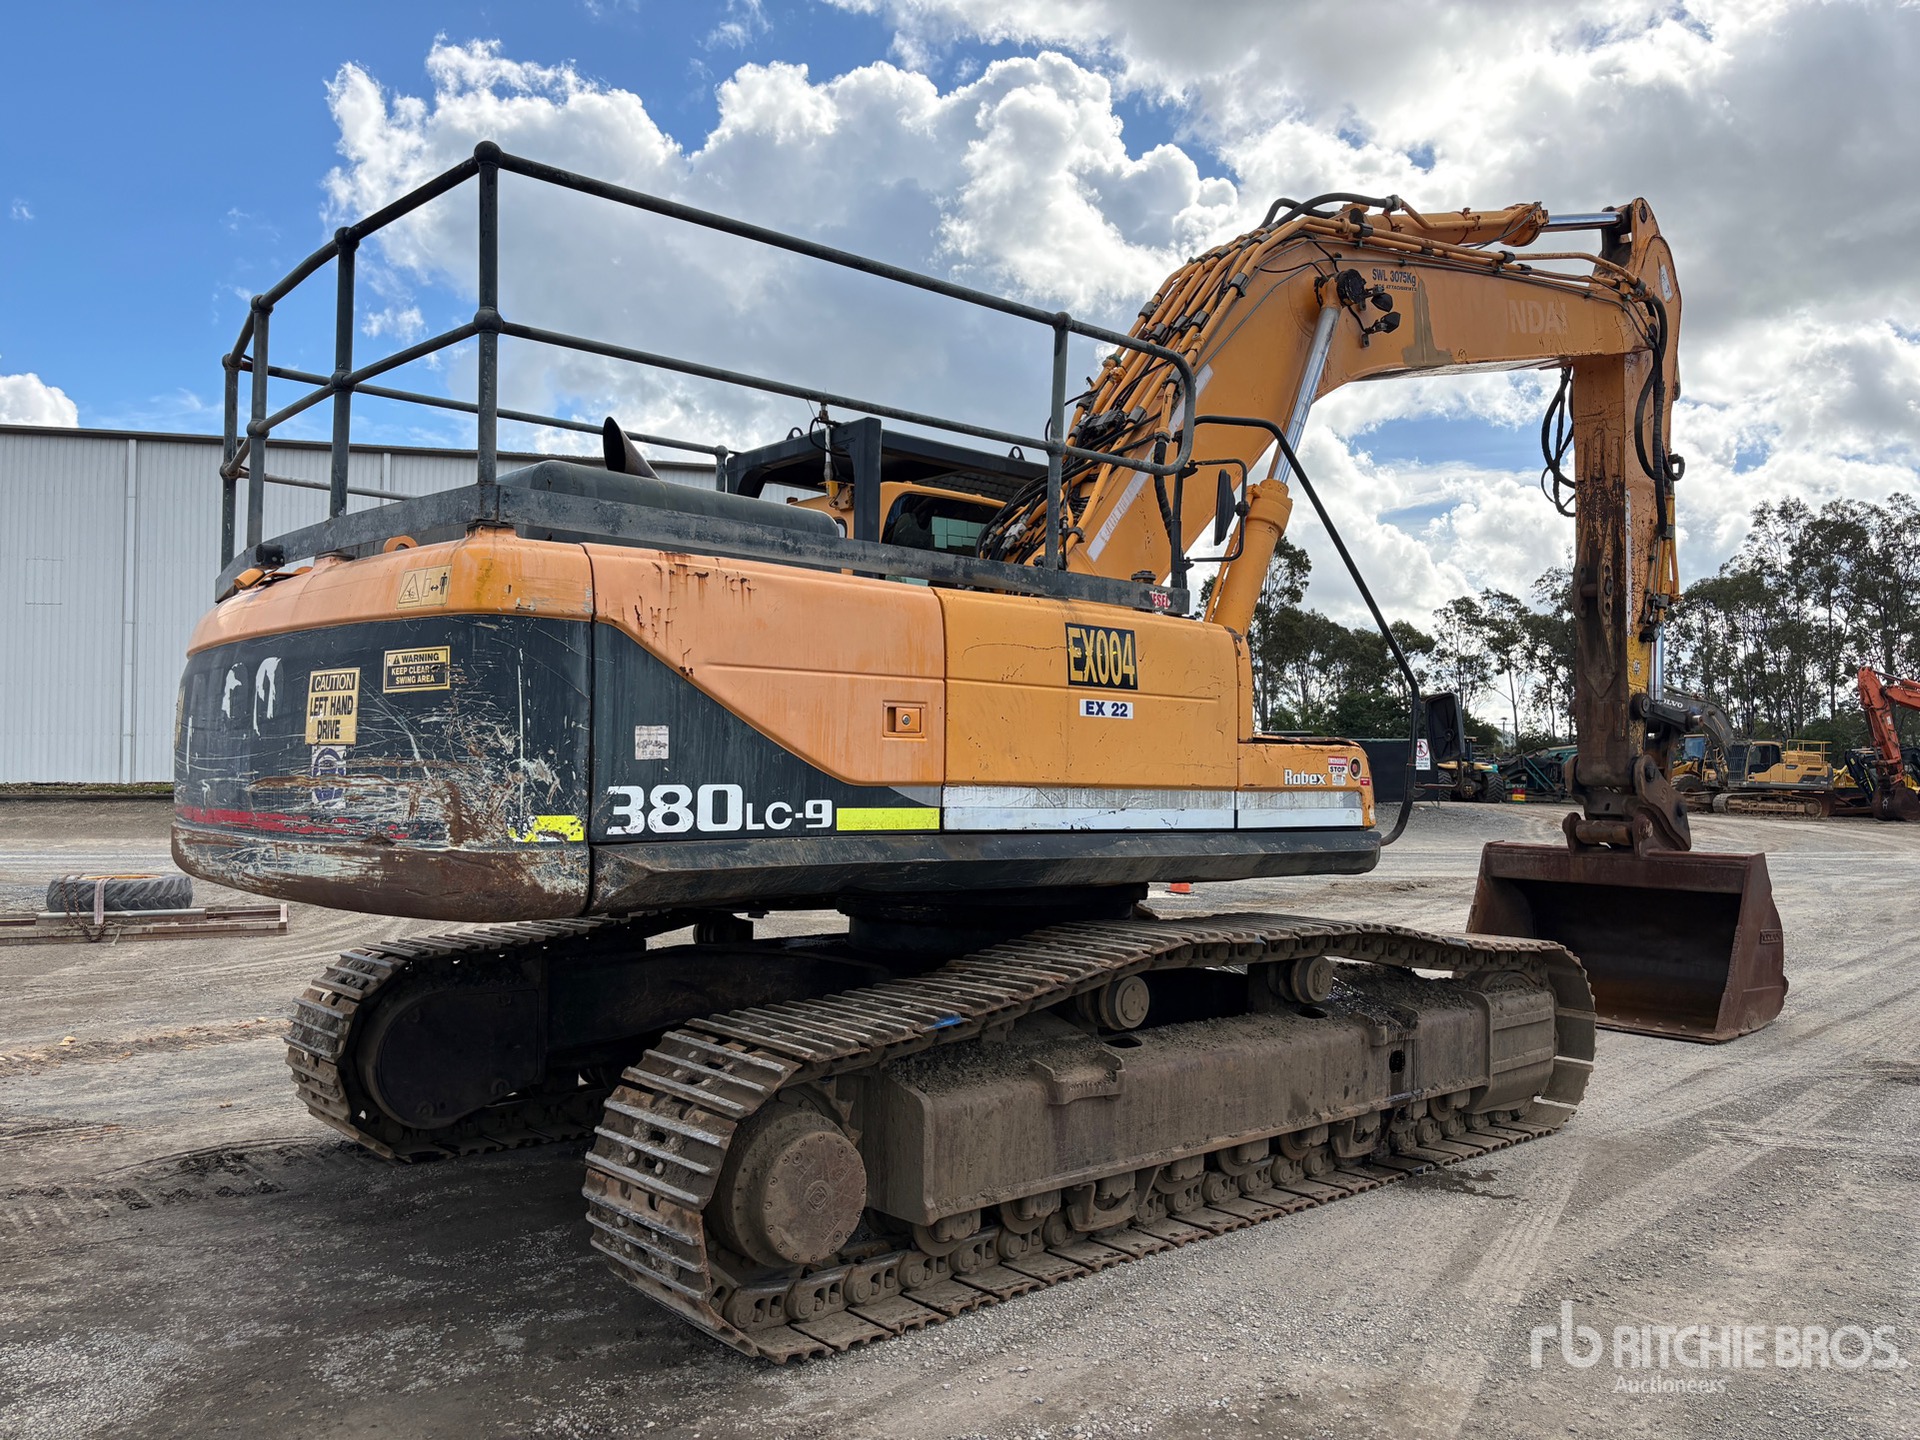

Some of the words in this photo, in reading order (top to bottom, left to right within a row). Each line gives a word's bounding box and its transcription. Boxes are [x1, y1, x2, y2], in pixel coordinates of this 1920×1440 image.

[1372, 268, 1387, 281] SWL
[401, 652, 440, 663] WARNING
[1067, 626, 1135, 686] EX004
[391, 667, 407, 676] KEEP
[408, 664, 430, 675] CLEAR
[314, 673, 354, 692] CAUTION
[395, 675, 417, 685] SWING
[417, 674, 436, 684] AREA
[309, 696, 329, 717] LEFT
[330, 694, 354, 716] HAND
[1085, 700, 1105, 716] EX
[1111, 702, 1128, 717] 22
[317, 719, 340, 740] DRIVE
